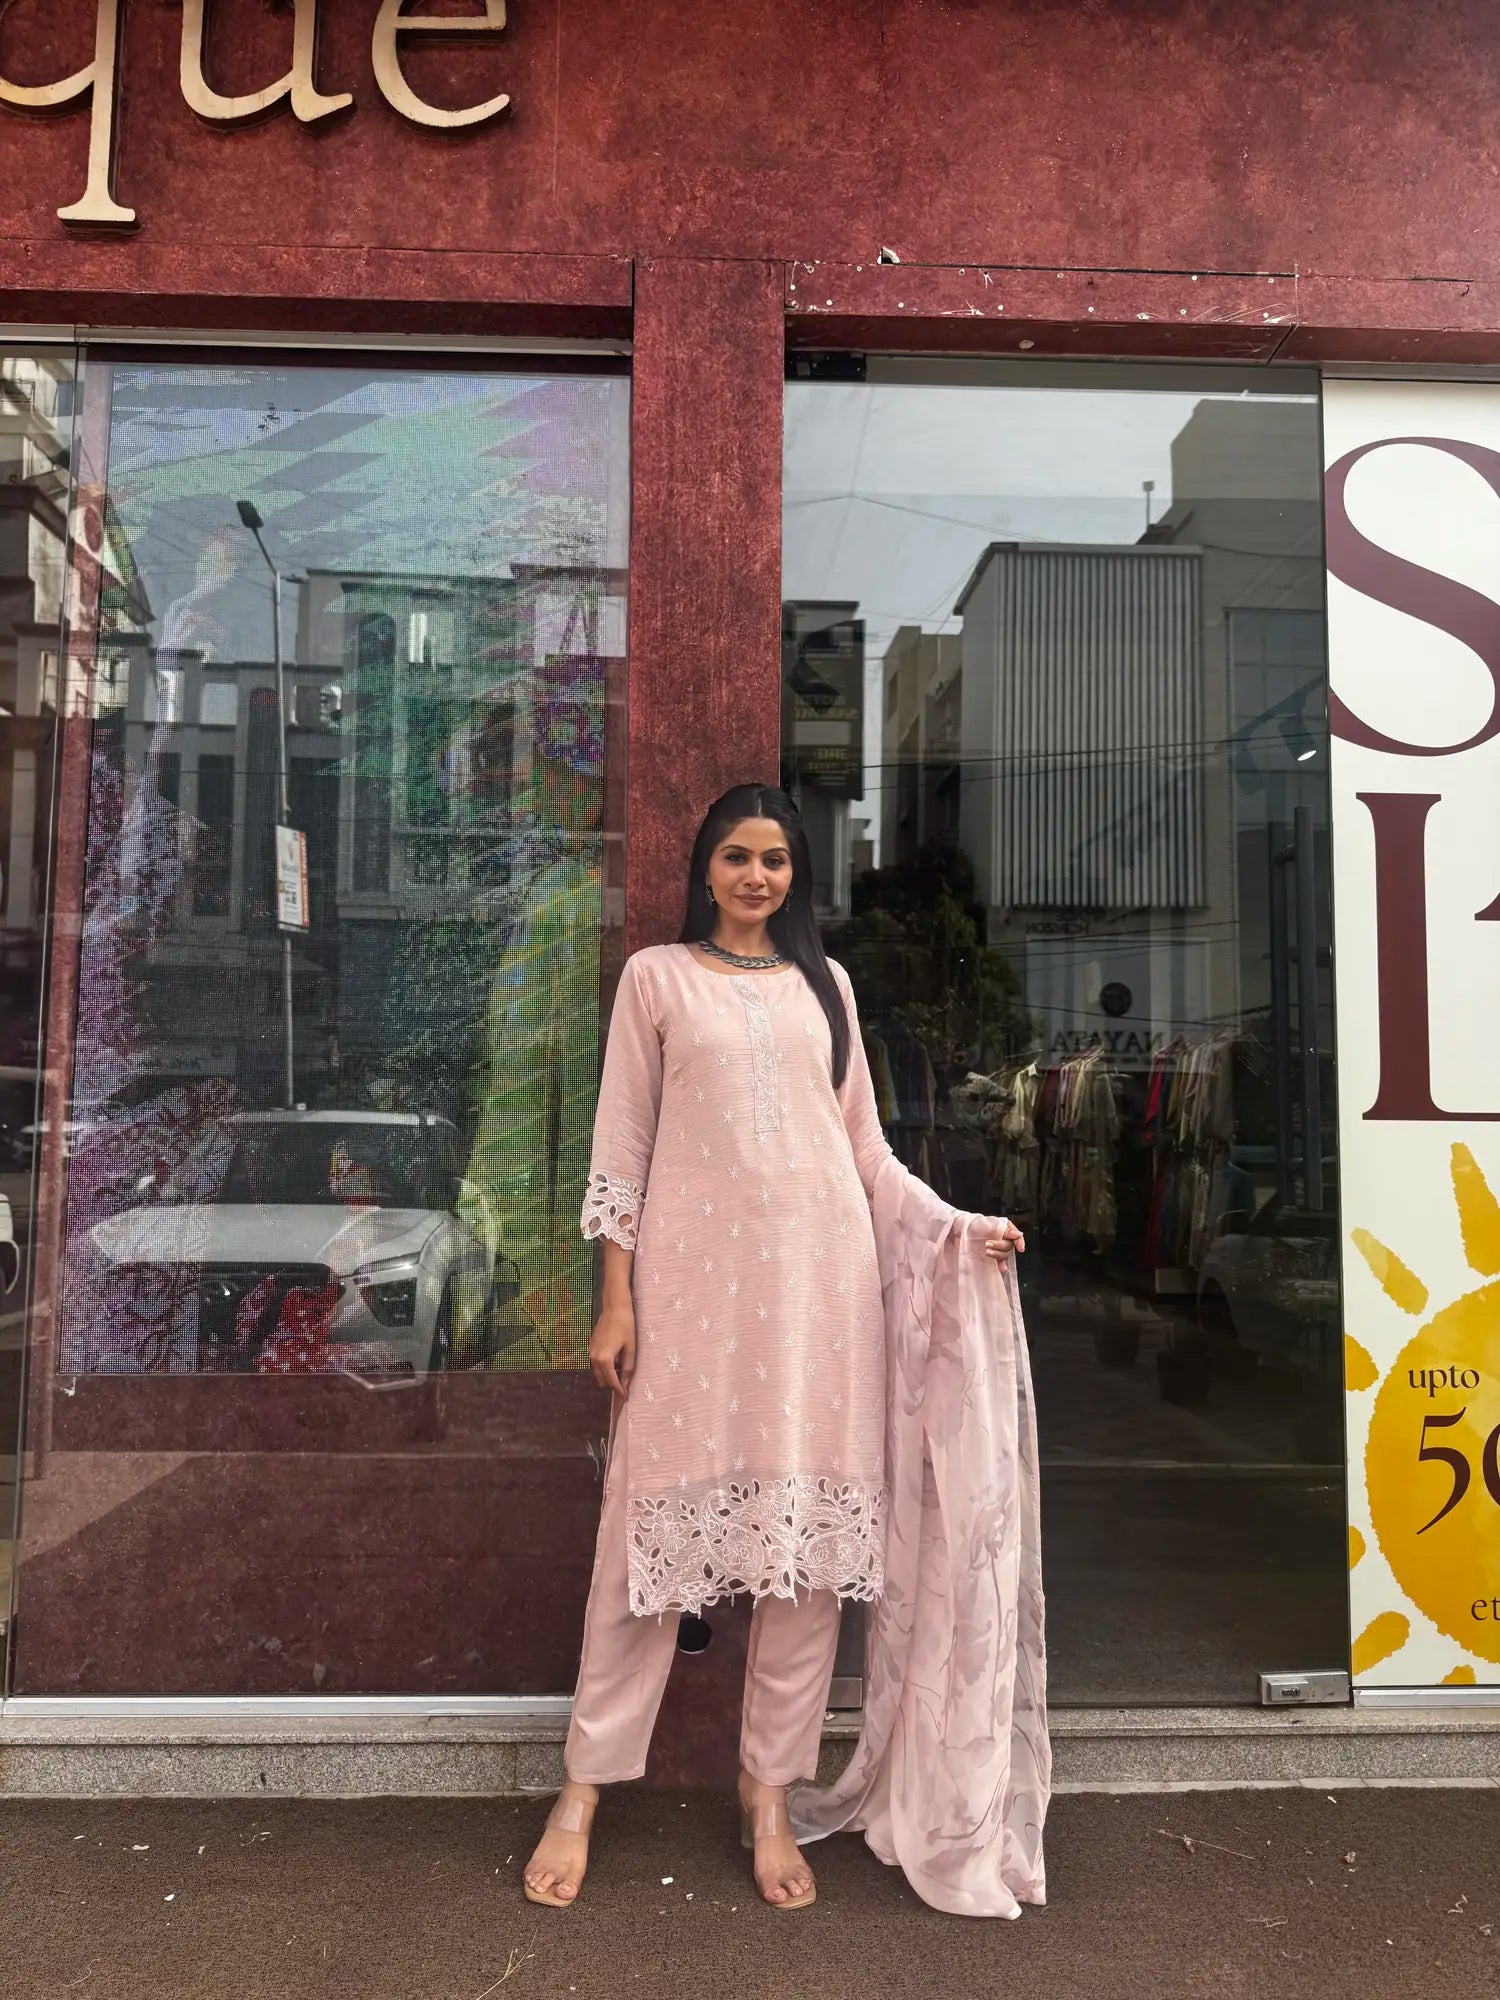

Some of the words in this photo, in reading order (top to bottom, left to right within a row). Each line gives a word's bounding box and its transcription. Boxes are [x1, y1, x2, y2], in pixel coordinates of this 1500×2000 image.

[0, 0, 511, 222] que
[1323, 436, 1500, 757] S
[1408, 1365, 1480, 1397] upto
